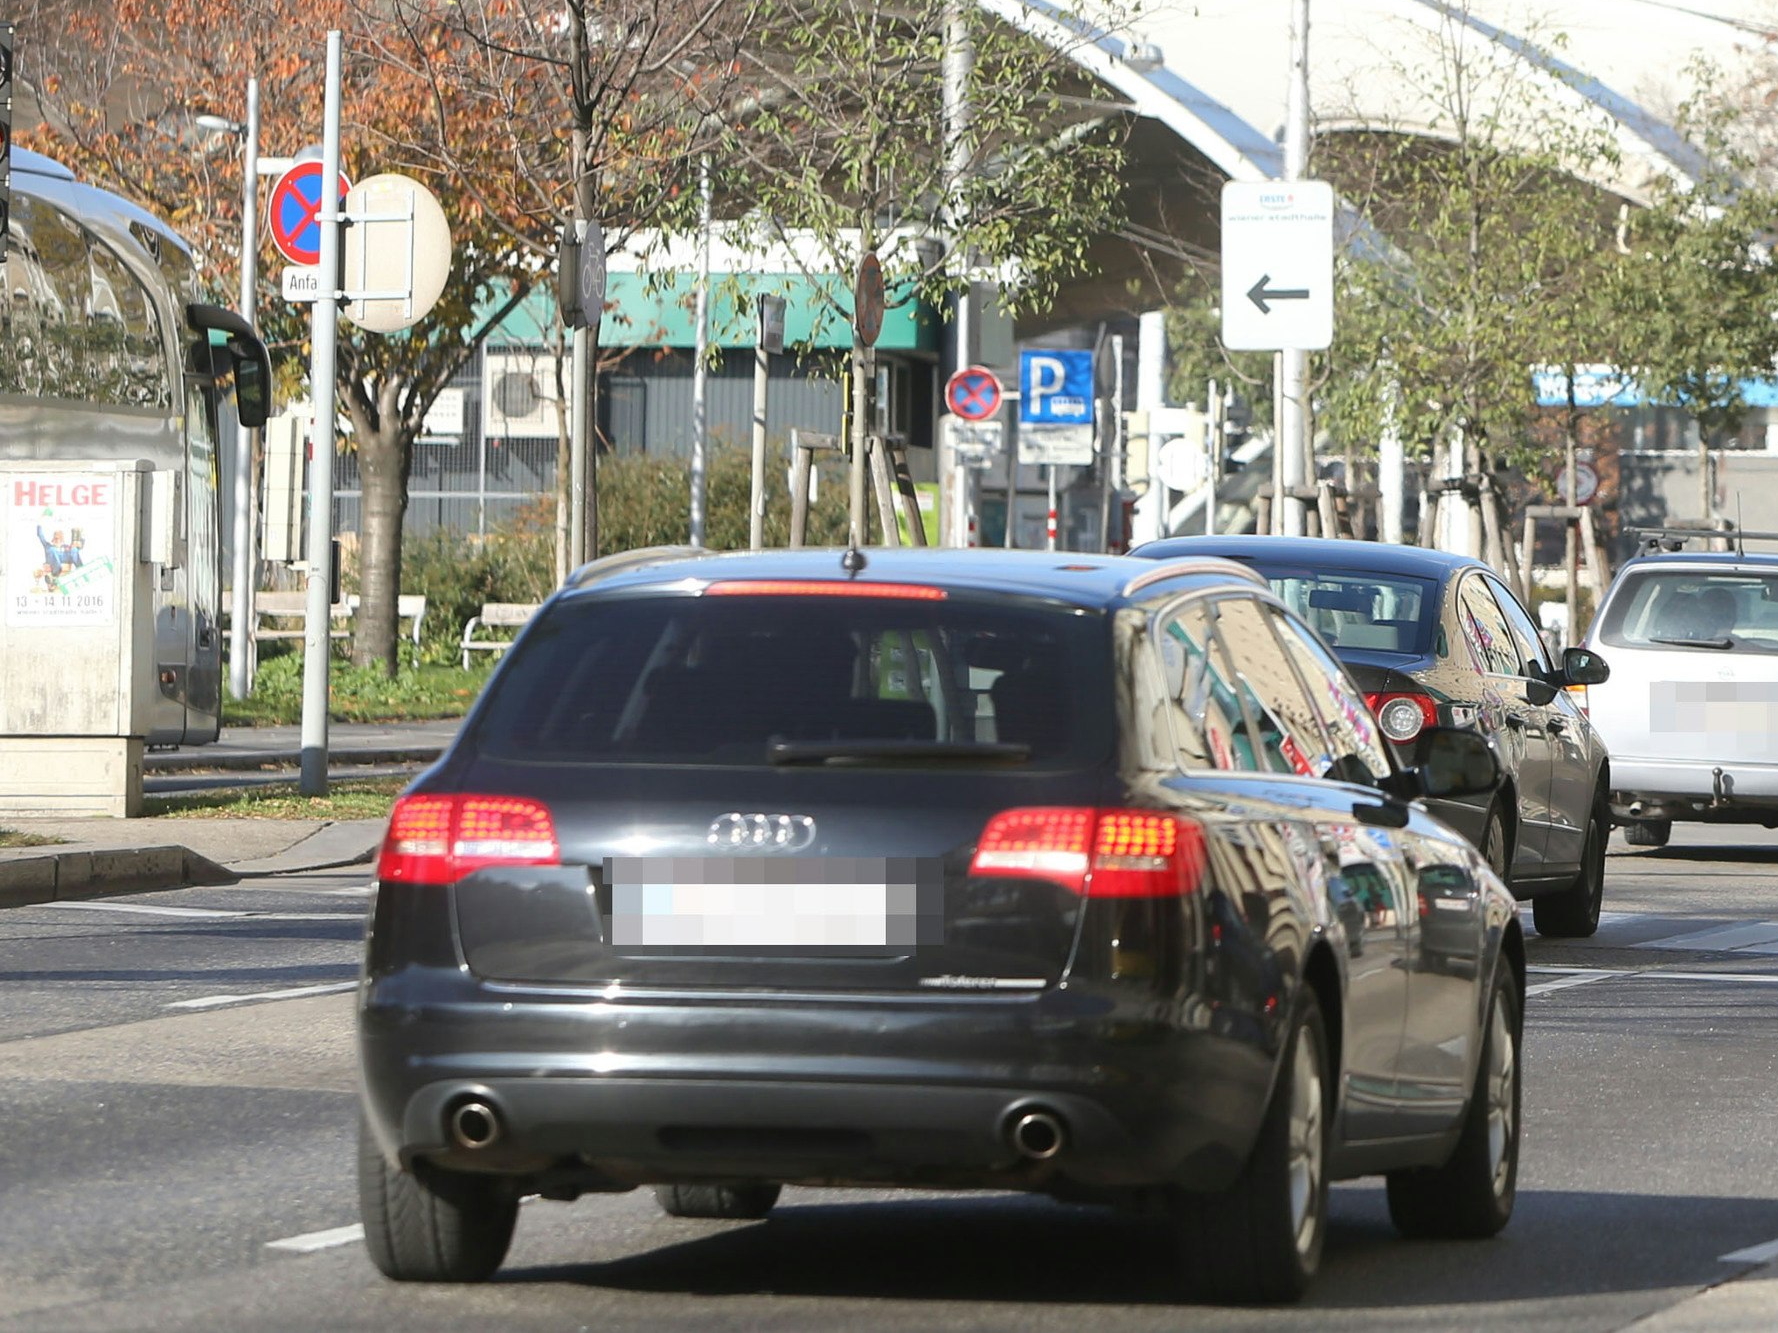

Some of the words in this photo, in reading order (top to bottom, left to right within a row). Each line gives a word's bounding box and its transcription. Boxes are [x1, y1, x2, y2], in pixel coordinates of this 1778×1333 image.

[289, 274, 318, 290] Anfa
[1030, 356, 1066, 415] P
[14, 481, 108, 506] HELGE
[77, 595, 104, 607] 2016
